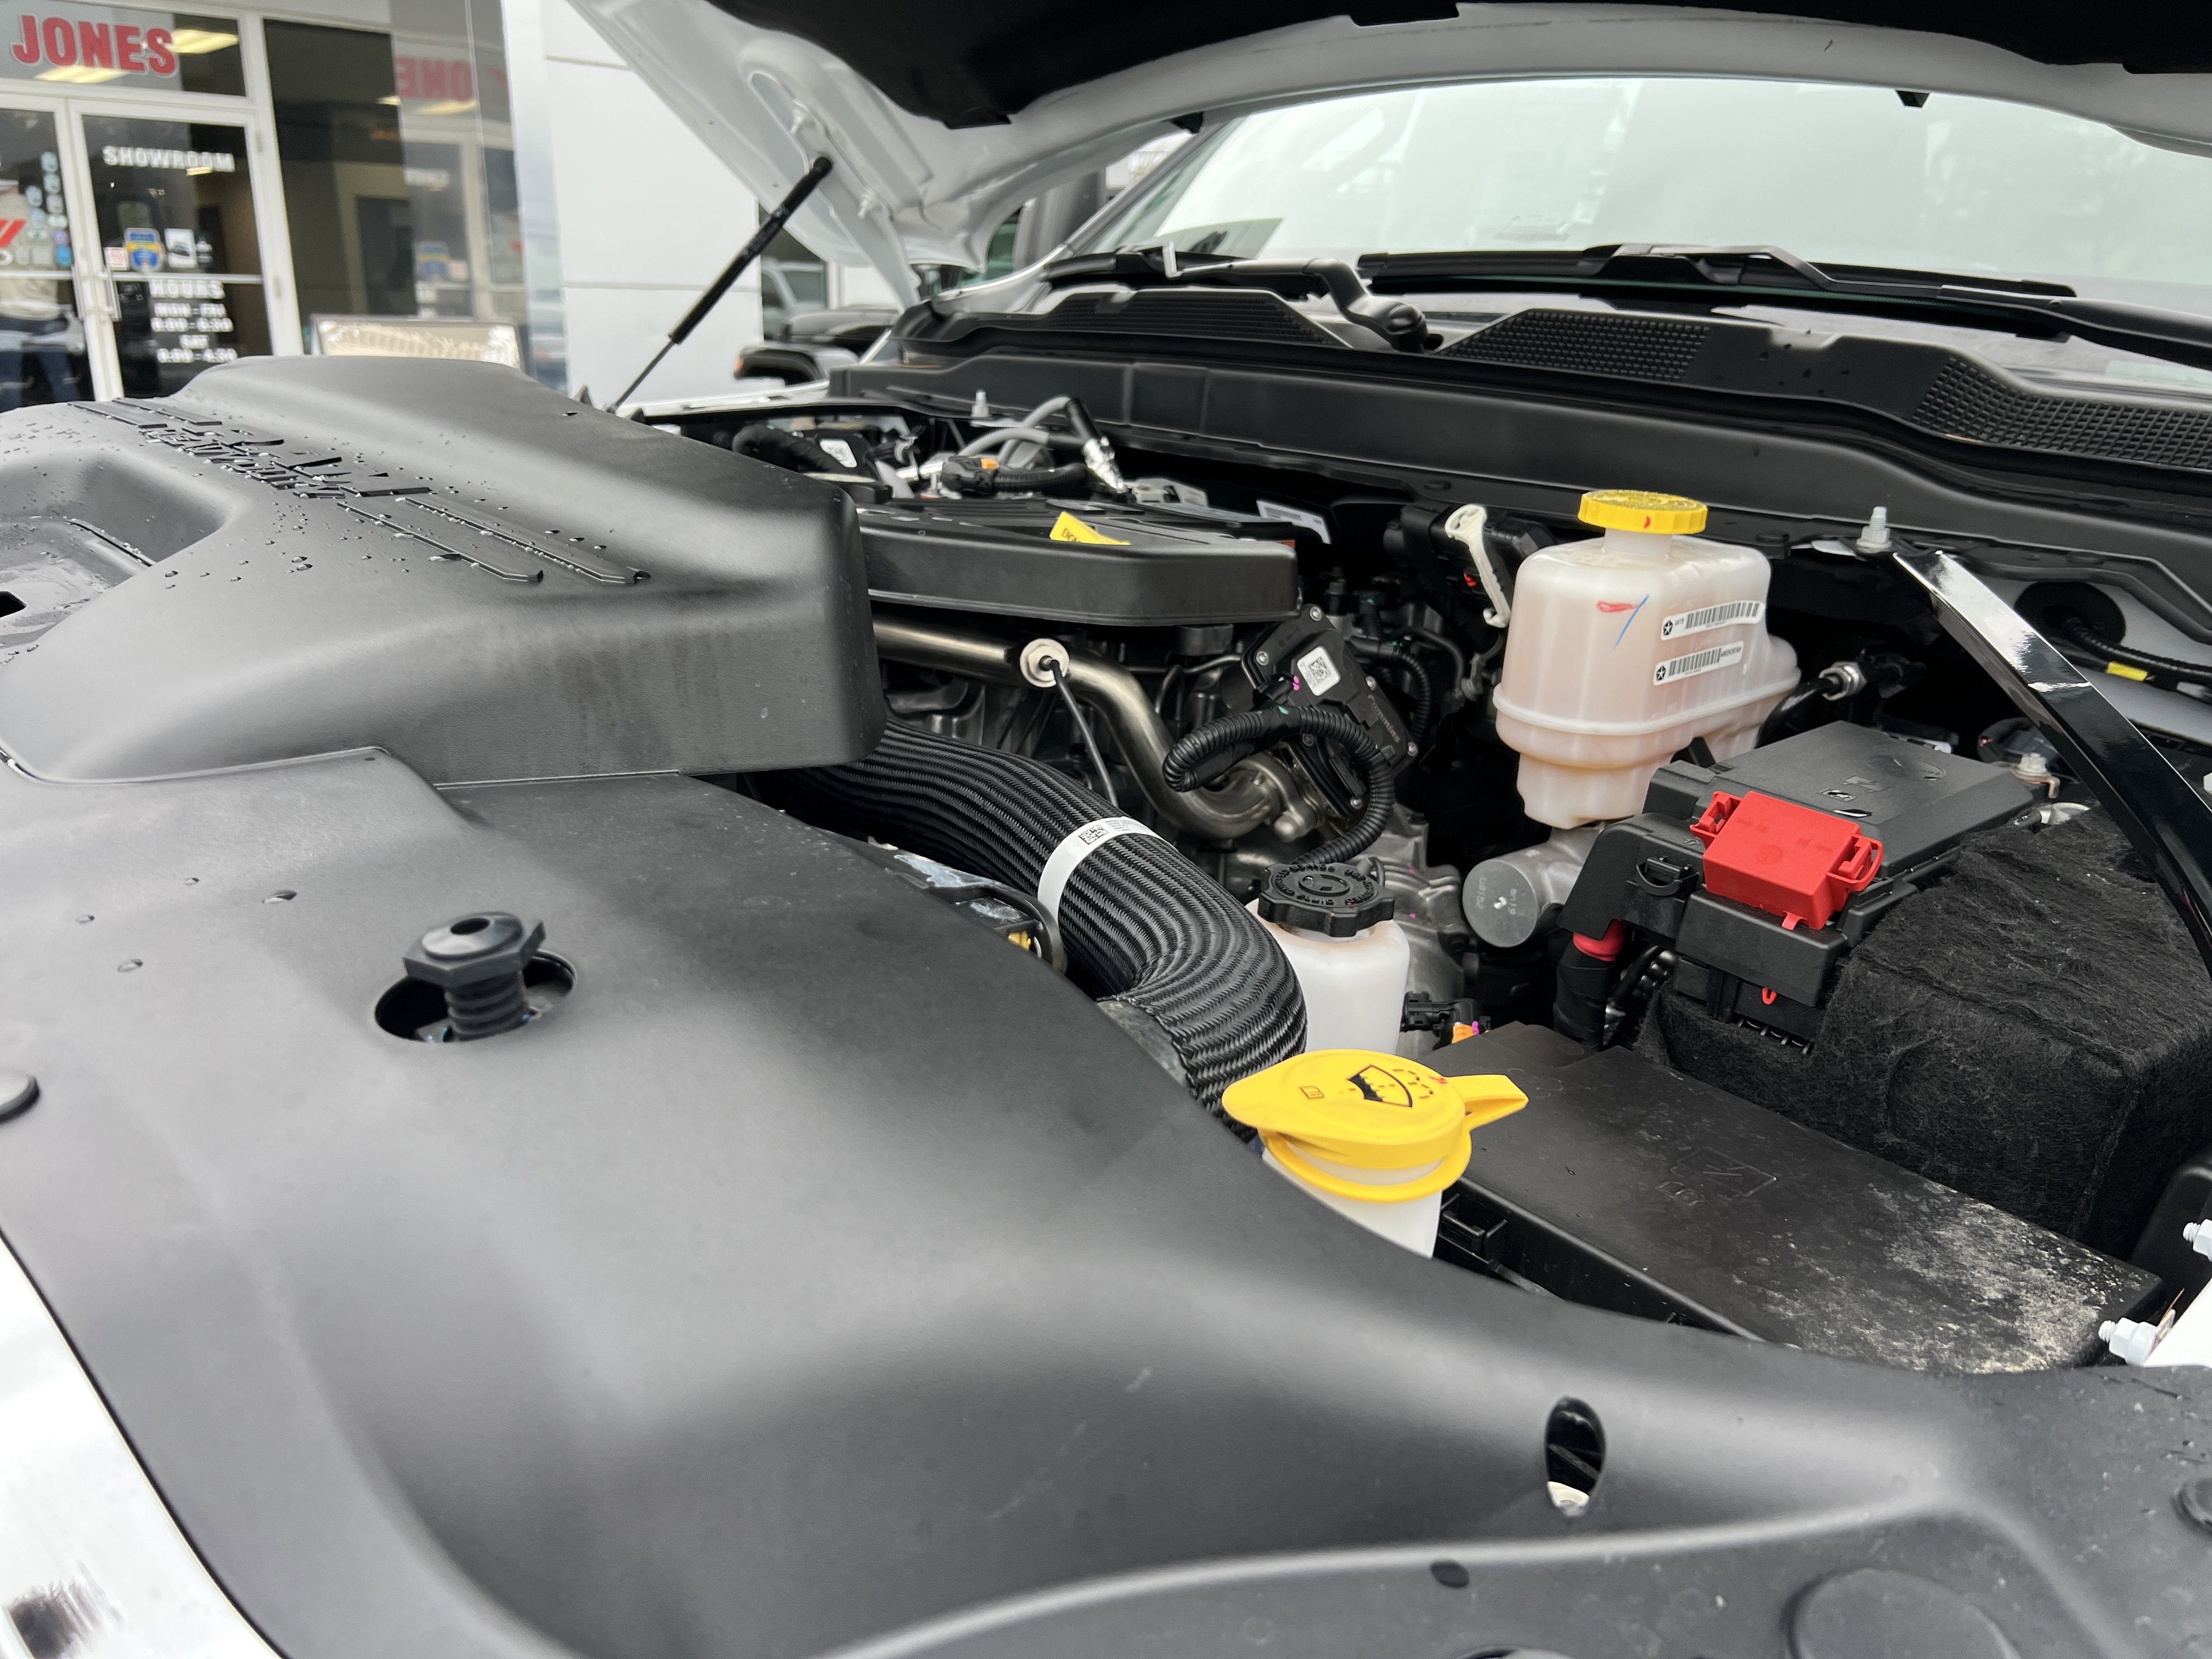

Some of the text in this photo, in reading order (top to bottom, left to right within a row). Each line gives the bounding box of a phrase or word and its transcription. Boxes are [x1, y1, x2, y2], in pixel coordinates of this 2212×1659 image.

[12, 15, 177, 76] JONES
[103, 146, 235, 173] SHOWROOM
[149, 279, 225, 299] HOURS
[154, 303, 192, 318] MON
[200, 303, 227, 318] FRI
[179, 334, 210, 349] SAT
